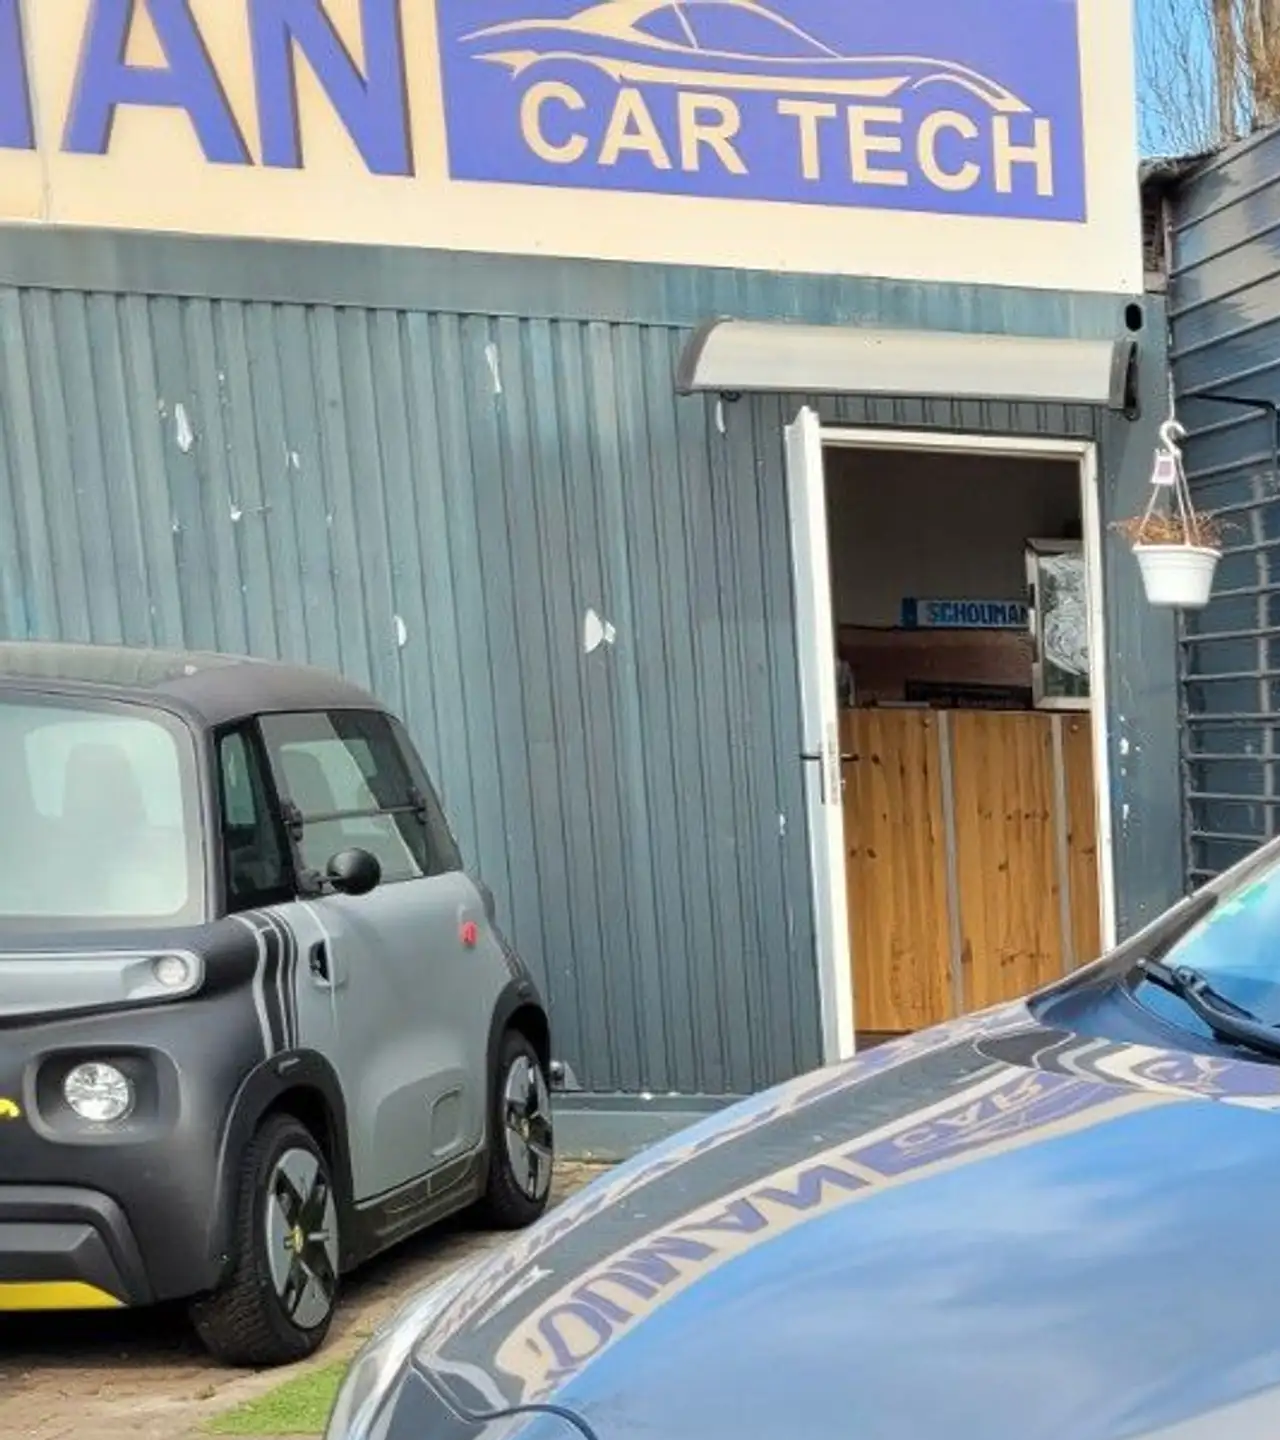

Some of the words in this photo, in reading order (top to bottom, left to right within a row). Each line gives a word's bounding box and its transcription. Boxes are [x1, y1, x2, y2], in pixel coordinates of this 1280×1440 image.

[0, 0, 416, 178] AN
[520, 80, 749, 175] CAR
[776, 98, 1055, 197] TECH
